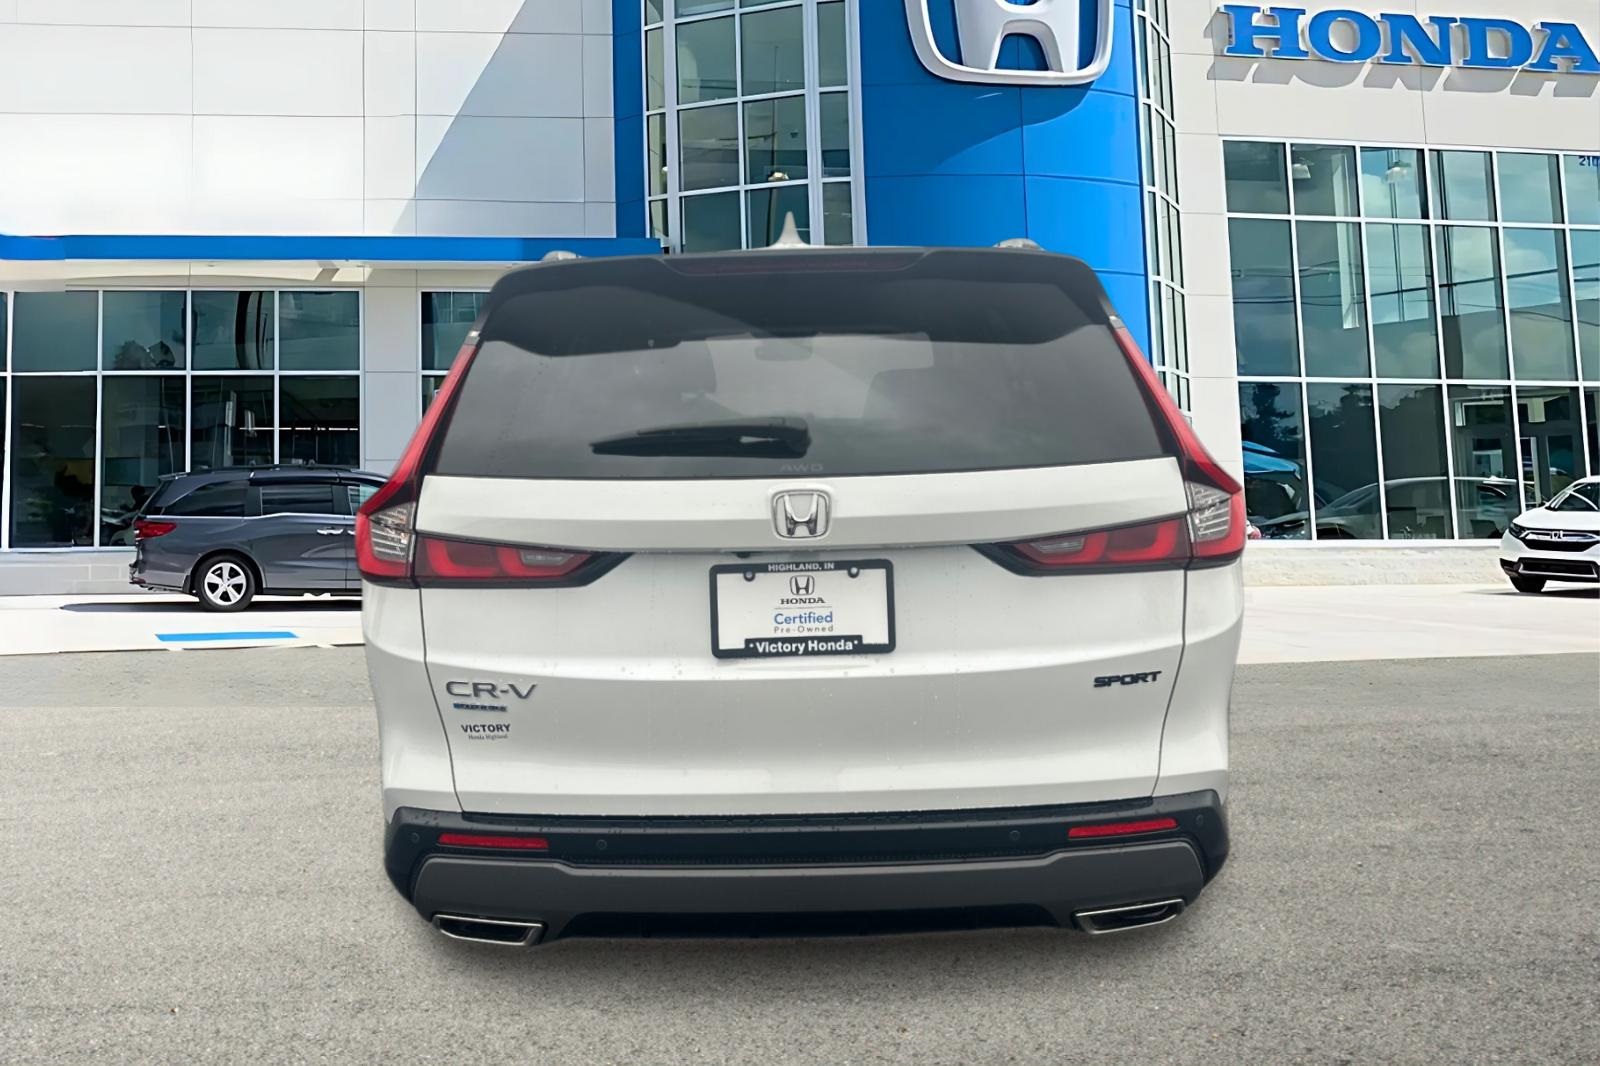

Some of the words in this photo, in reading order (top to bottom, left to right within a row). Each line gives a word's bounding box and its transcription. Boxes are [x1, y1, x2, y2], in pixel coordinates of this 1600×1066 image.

[1222, 3, 1600, 73] HONDA
[780, 463, 824, 472] AWD
[824, 562, 835, 570] IN
[780, 597, 825, 605] HONDA
[774, 611, 833, 625] Certified
[774, 625, 834, 634] Pre-Owned
[755, 641, 807, 654] Victory
[808, 640, 853, 652] Honda
[1093, 670, 1162, 688] SPORT
[446, 681, 538, 699] CR-V
[461, 723, 511, 733] VICTORY
